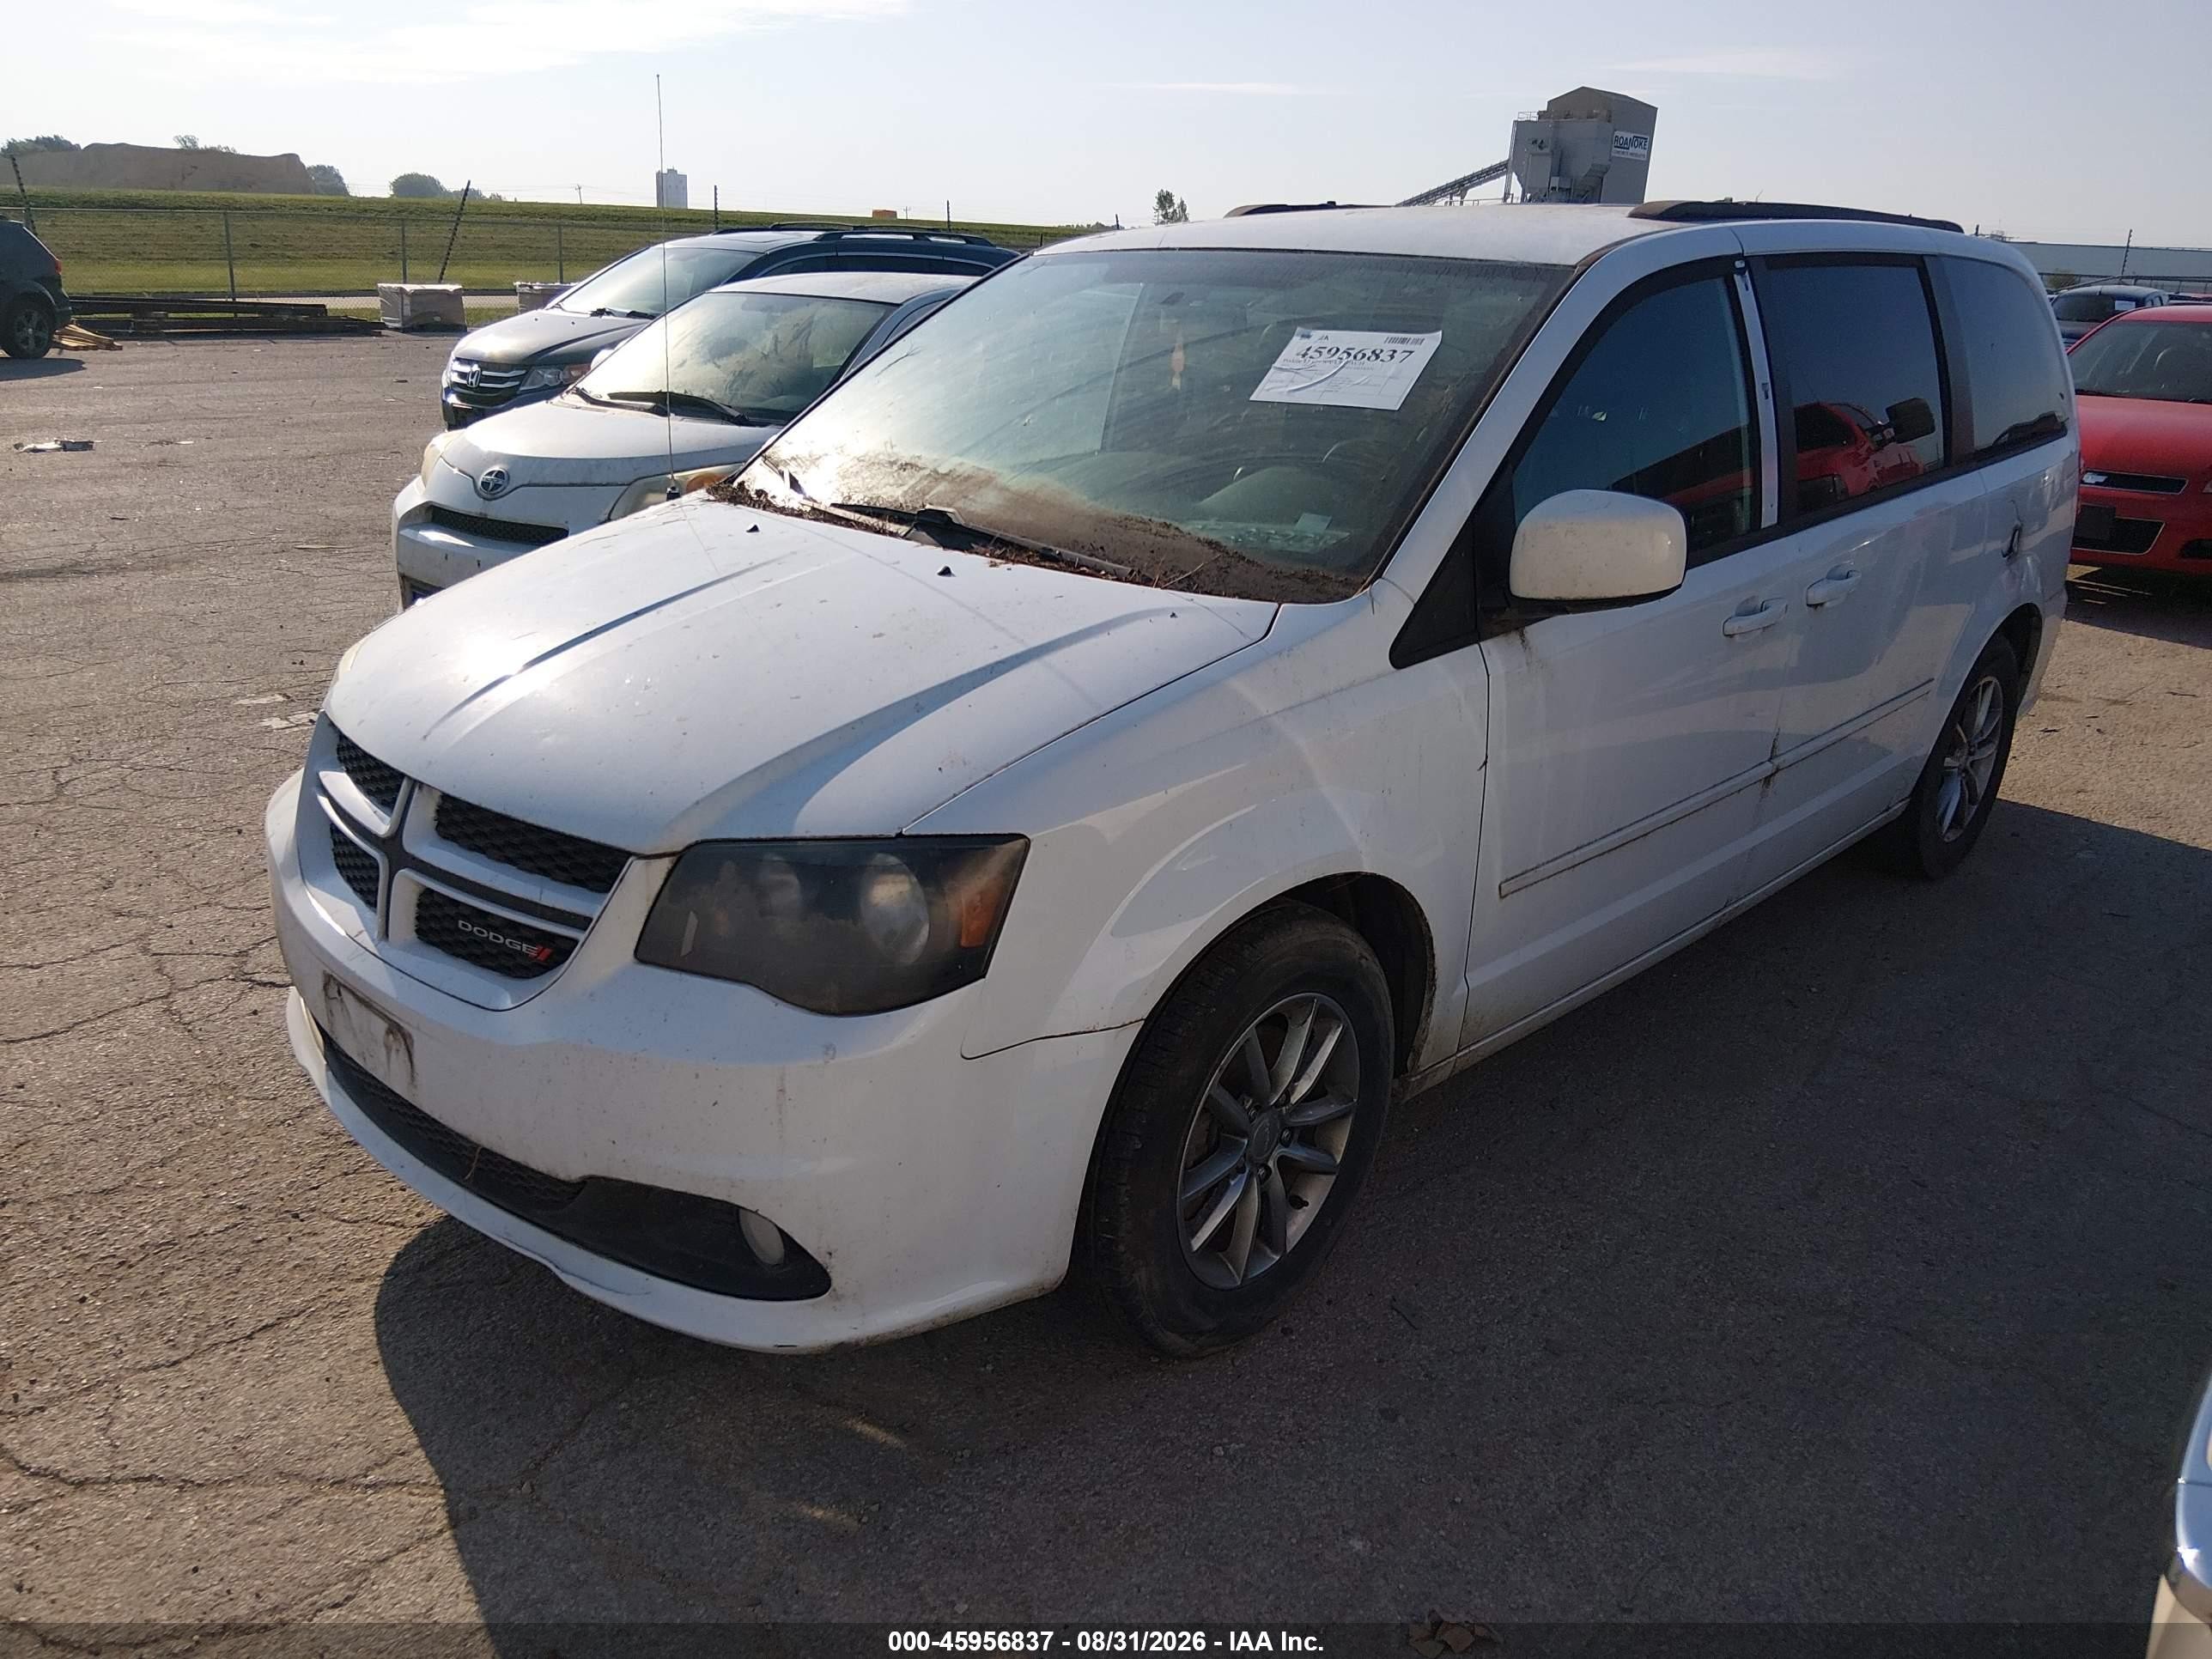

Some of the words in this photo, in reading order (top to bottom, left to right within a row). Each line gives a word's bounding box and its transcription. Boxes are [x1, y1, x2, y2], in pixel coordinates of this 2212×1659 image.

[1614, 135, 1648, 149] ROANOKE
[1295, 345, 1415, 364] 45956837
[458, 920, 538, 957] DODGE
